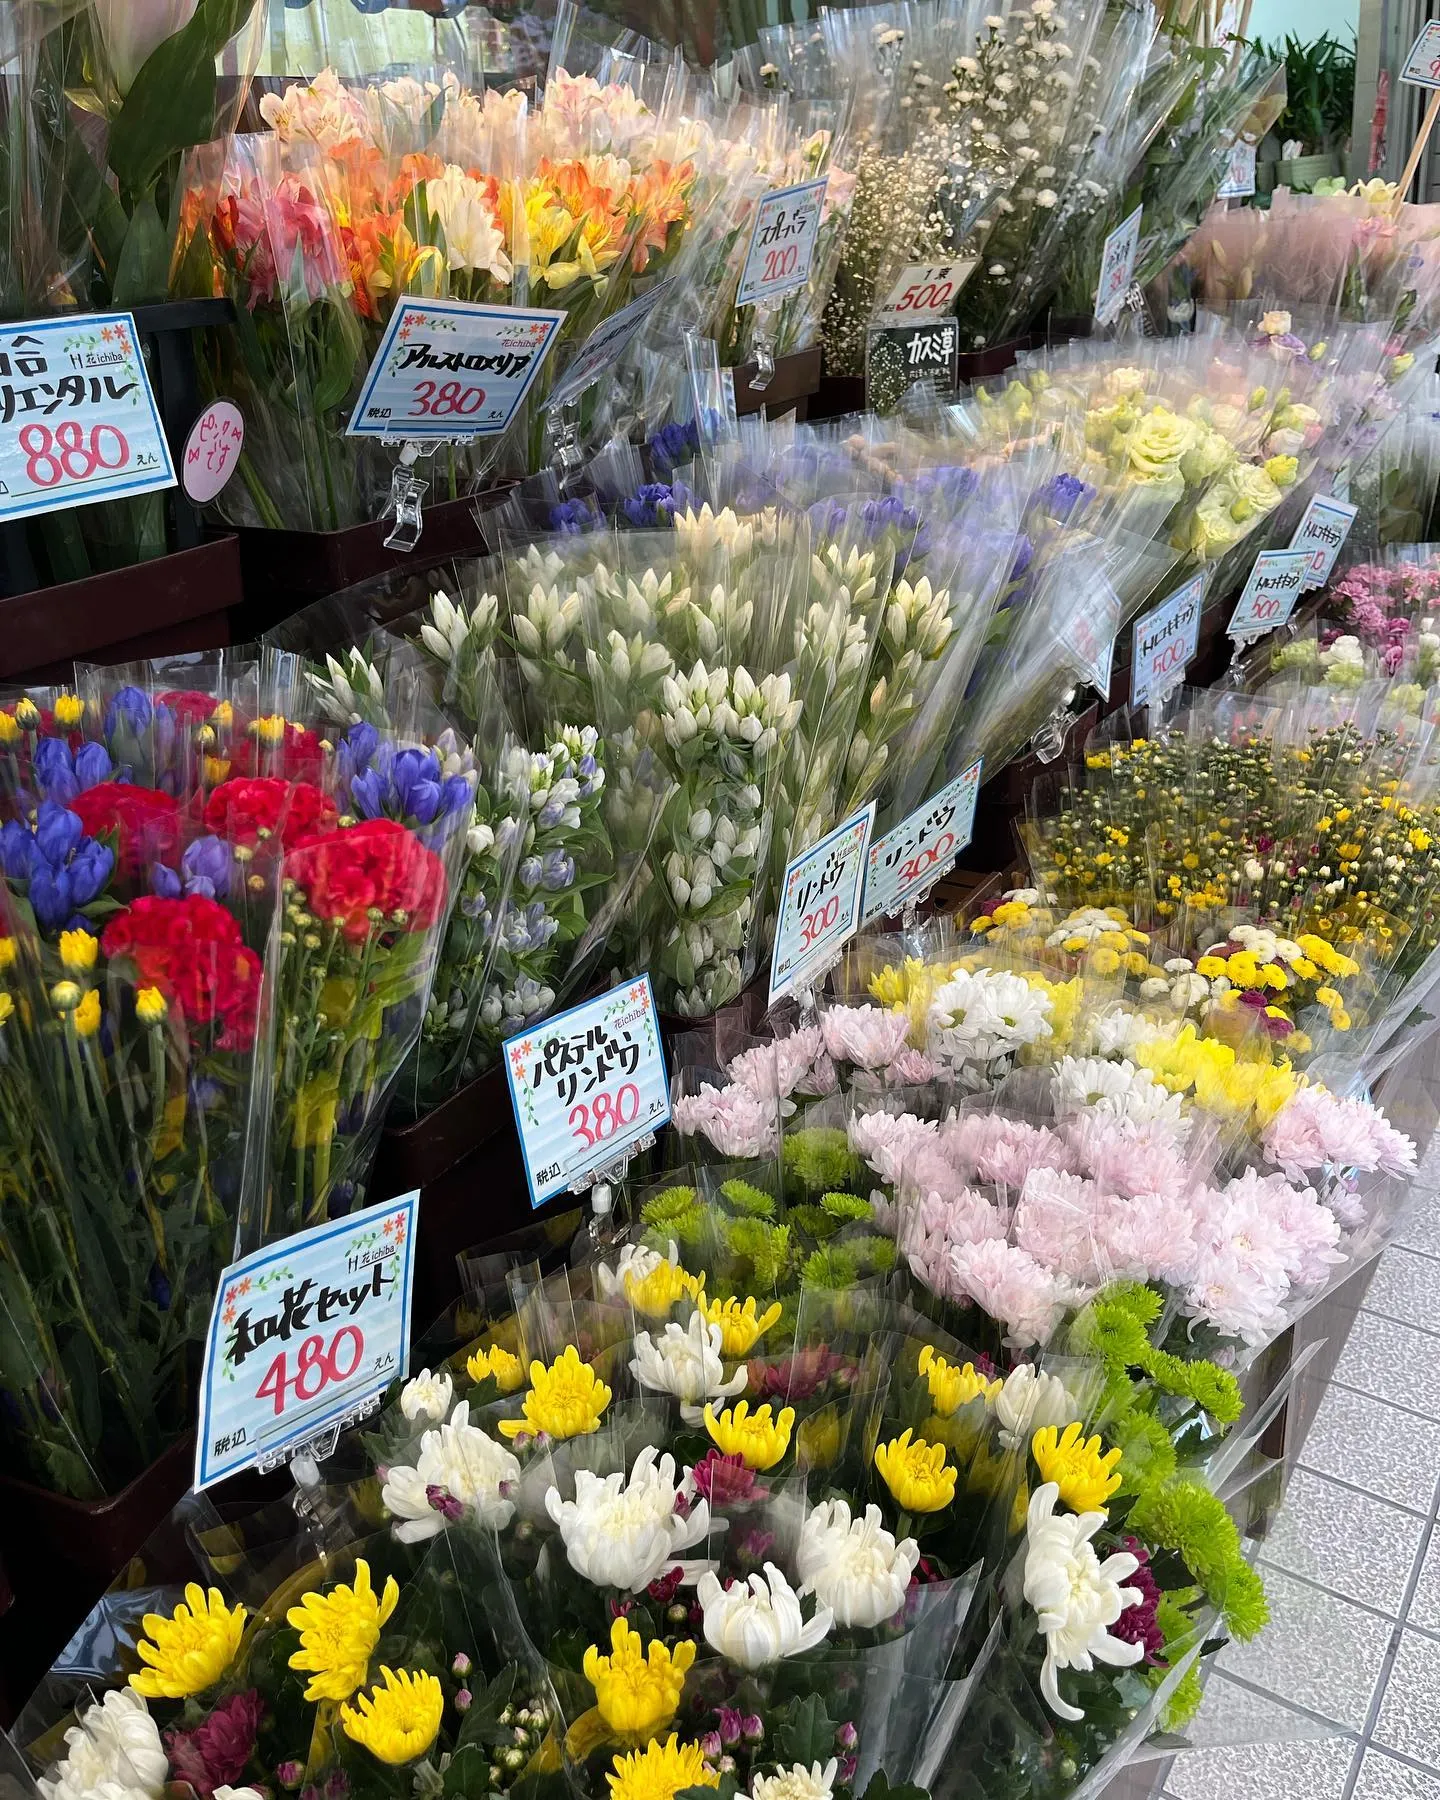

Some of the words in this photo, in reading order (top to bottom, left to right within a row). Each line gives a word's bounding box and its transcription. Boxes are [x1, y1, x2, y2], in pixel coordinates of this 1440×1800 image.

[761, 245, 798, 281] 200
[896, 282, 952, 311] 500
[398, 343, 531, 378] アルストロメリア
[906, 327, 955, 365] カスミ草
[407, 381, 486, 416] 380
[200, 413, 231, 442] ピンク
[19, 421, 130, 487] 880
[136, 452, 158, 466] えん
[207, 439, 230, 474] です
[1251, 594, 1280, 619] 500
[1152, 638, 1185, 681] 500
[886, 805, 956, 868] リンドウ
[896, 832, 955, 891] 300
[797, 852, 846, 917] リンドウ
[798, 895, 839, 953] 300
[613, 1008, 647, 1030] 花ichiba
[533, 1025, 608, 1088] パステル
[557, 1031, 640, 1107] リンドウ
[568, 1082, 640, 1153] 380
[649, 1100, 665, 1115] えん
[225, 1262, 395, 1367] 和花セット
[255, 1324, 364, 1416] 480
[374, 1352, 395, 1371] えん
